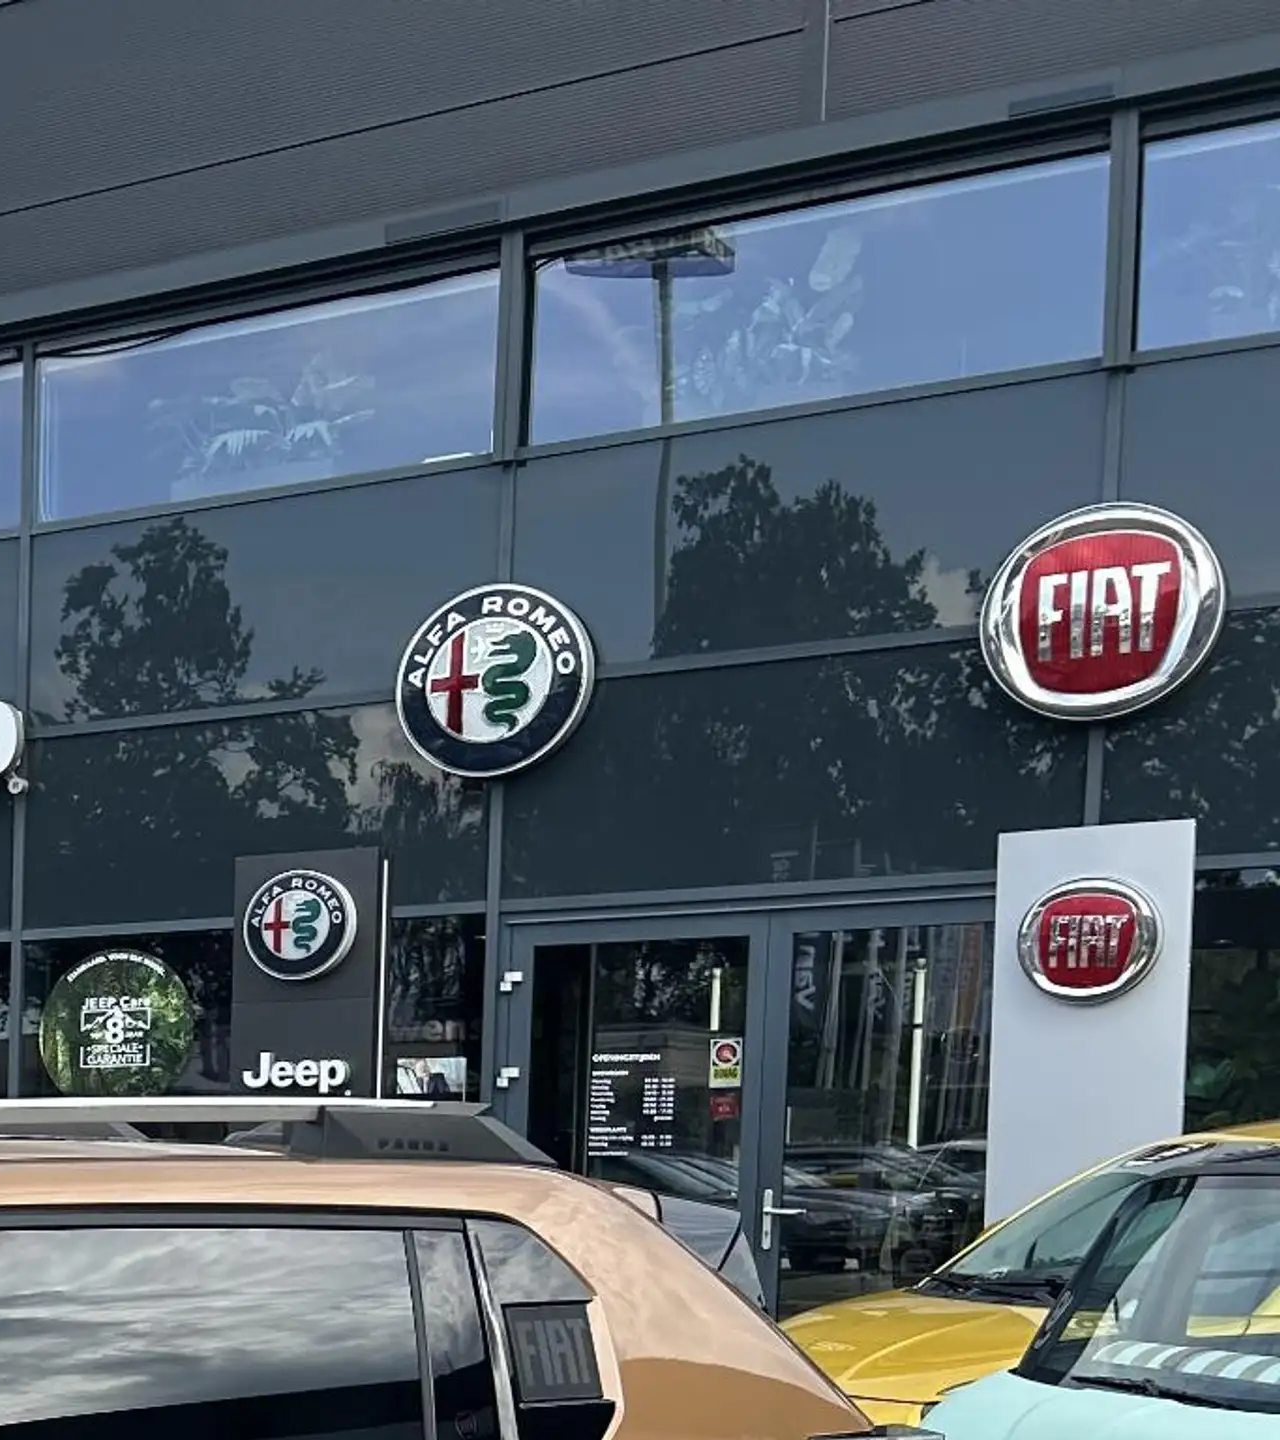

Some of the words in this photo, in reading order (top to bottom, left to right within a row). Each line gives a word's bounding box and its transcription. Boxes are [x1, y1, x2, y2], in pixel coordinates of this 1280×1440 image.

[1038, 561, 1172, 661] FIAT
[407, 611, 466, 688] ALFA
[481, 596, 576, 675] ROMEO
[250, 885, 284, 927] ALFA
[291, 877, 343, 924] ROMEO
[1048, 914, 1130, 969] FIAT
[105, 1017, 125, 1044] 8
[242, 1052, 349, 1094] Jeep
[514, 1318, 591, 1387] FIAT
